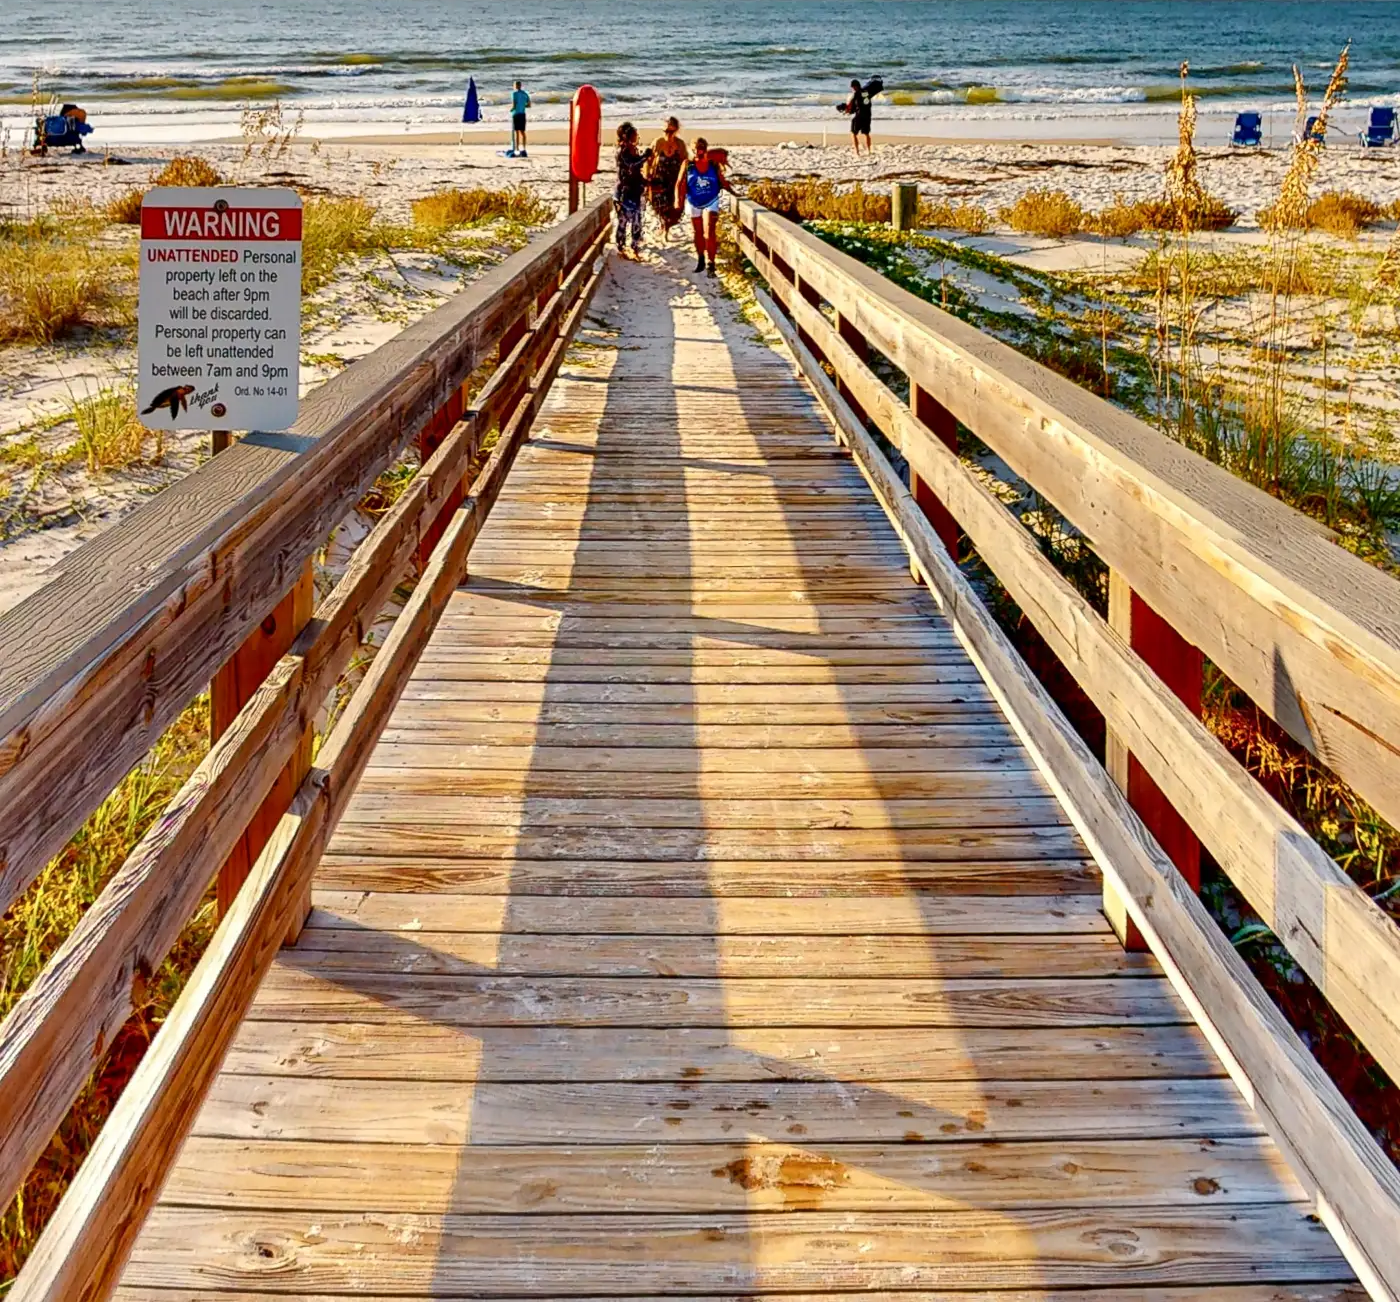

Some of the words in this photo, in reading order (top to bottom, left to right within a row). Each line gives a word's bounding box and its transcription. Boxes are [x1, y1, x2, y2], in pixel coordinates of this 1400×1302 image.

[164, 211, 280, 237] WARNING
[148, 249, 238, 262] UNATTENDED
[244, 250, 296, 263] Personal
[166, 270, 215, 285] property
[219, 269, 236, 281] left
[241, 272, 255, 282] on
[259, 270, 277, 282] the
[173, 287, 209, 300] beach
[213, 288, 240, 301] after
[244, 289, 270, 303] 9pm
[170, 307, 188, 319] will
[192, 307, 207, 319] be
[211, 307, 272, 320] discarded.
[156, 325, 207, 338] Personal
[212, 328, 260, 341] property
[264, 329, 286, 339] can
[167, 345, 181, 357] be
[186, 345, 203, 357] left
[207, 345, 274, 358] unattended
[152, 364, 202, 376] between
[207, 364, 232, 376] 7am
[236, 365, 258, 377] and
[262, 364, 288, 380] 9pm
[190, 383, 219, 405] thank
[235, 386, 250, 396] Ord.
[253, 387, 264, 396] No
[267, 387, 287, 396] 14-01
[199, 394, 217, 409] you
